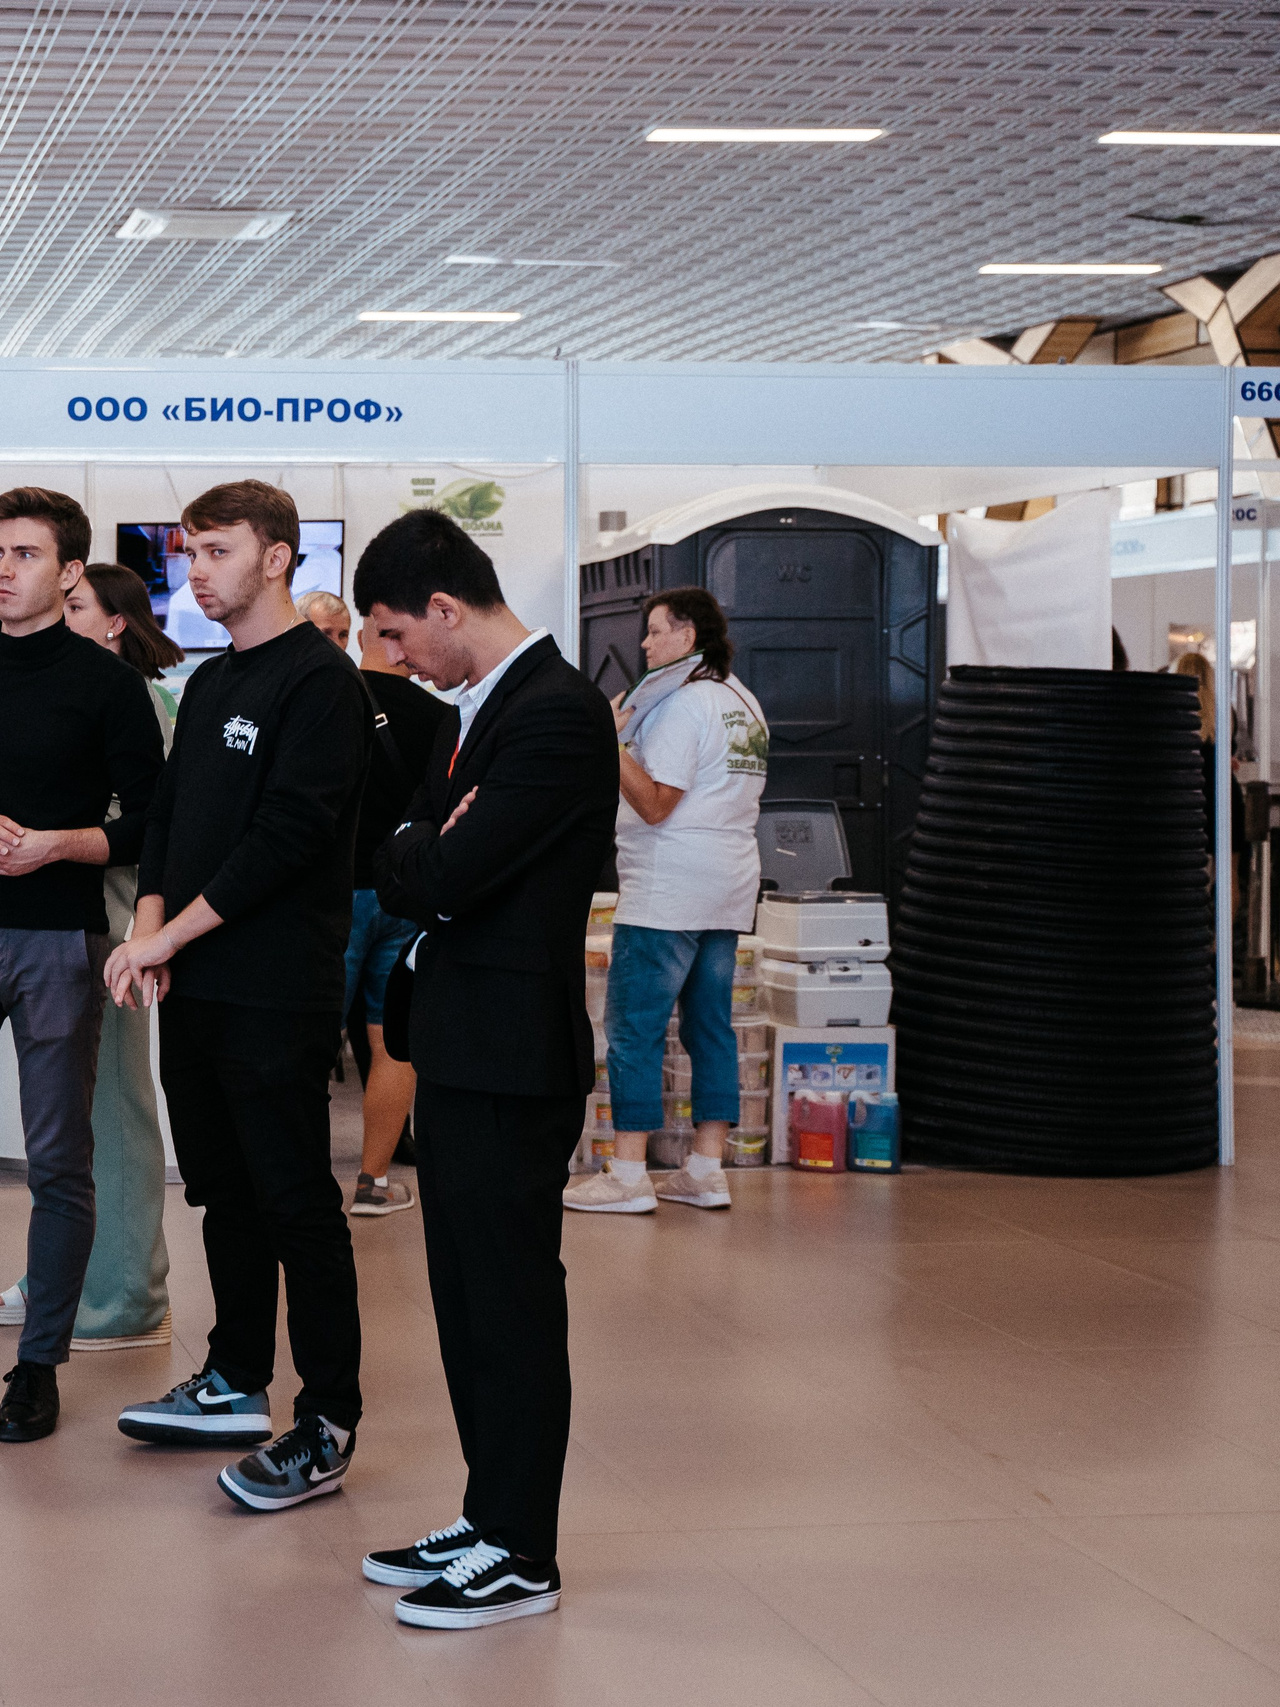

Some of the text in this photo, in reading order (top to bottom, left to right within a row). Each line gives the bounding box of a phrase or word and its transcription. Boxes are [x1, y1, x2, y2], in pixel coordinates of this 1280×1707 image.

[67, 396, 403, 423] ООО «БИО-ПРОФ»
[1232, 508, 1257, 521] 0C
